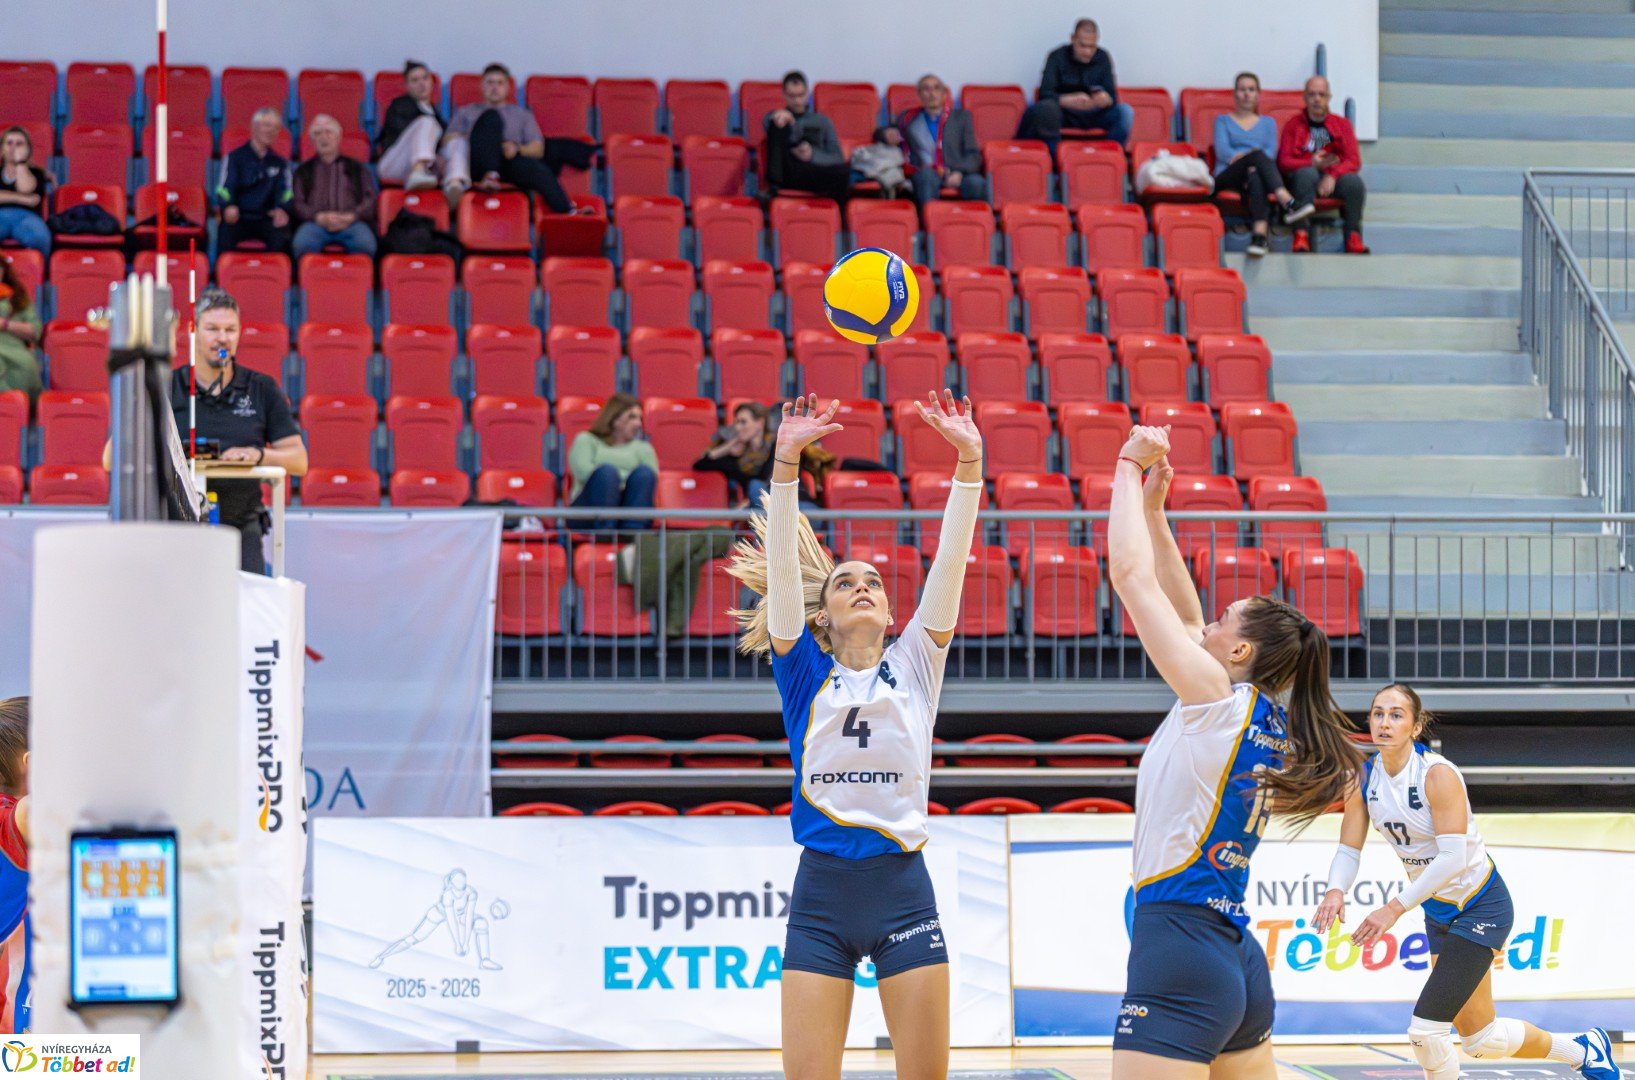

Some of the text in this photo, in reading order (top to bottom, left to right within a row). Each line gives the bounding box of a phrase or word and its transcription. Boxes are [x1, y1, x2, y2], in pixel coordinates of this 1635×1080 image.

[248, 640, 283, 834] TippmixPRO
[842, 707, 871, 748] 4
[1383, 822, 1411, 846] 17
[252, 921, 286, 1080] TippmixPR
[387, 978, 427, 998] 2025
[441, 977, 481, 998] 2026
